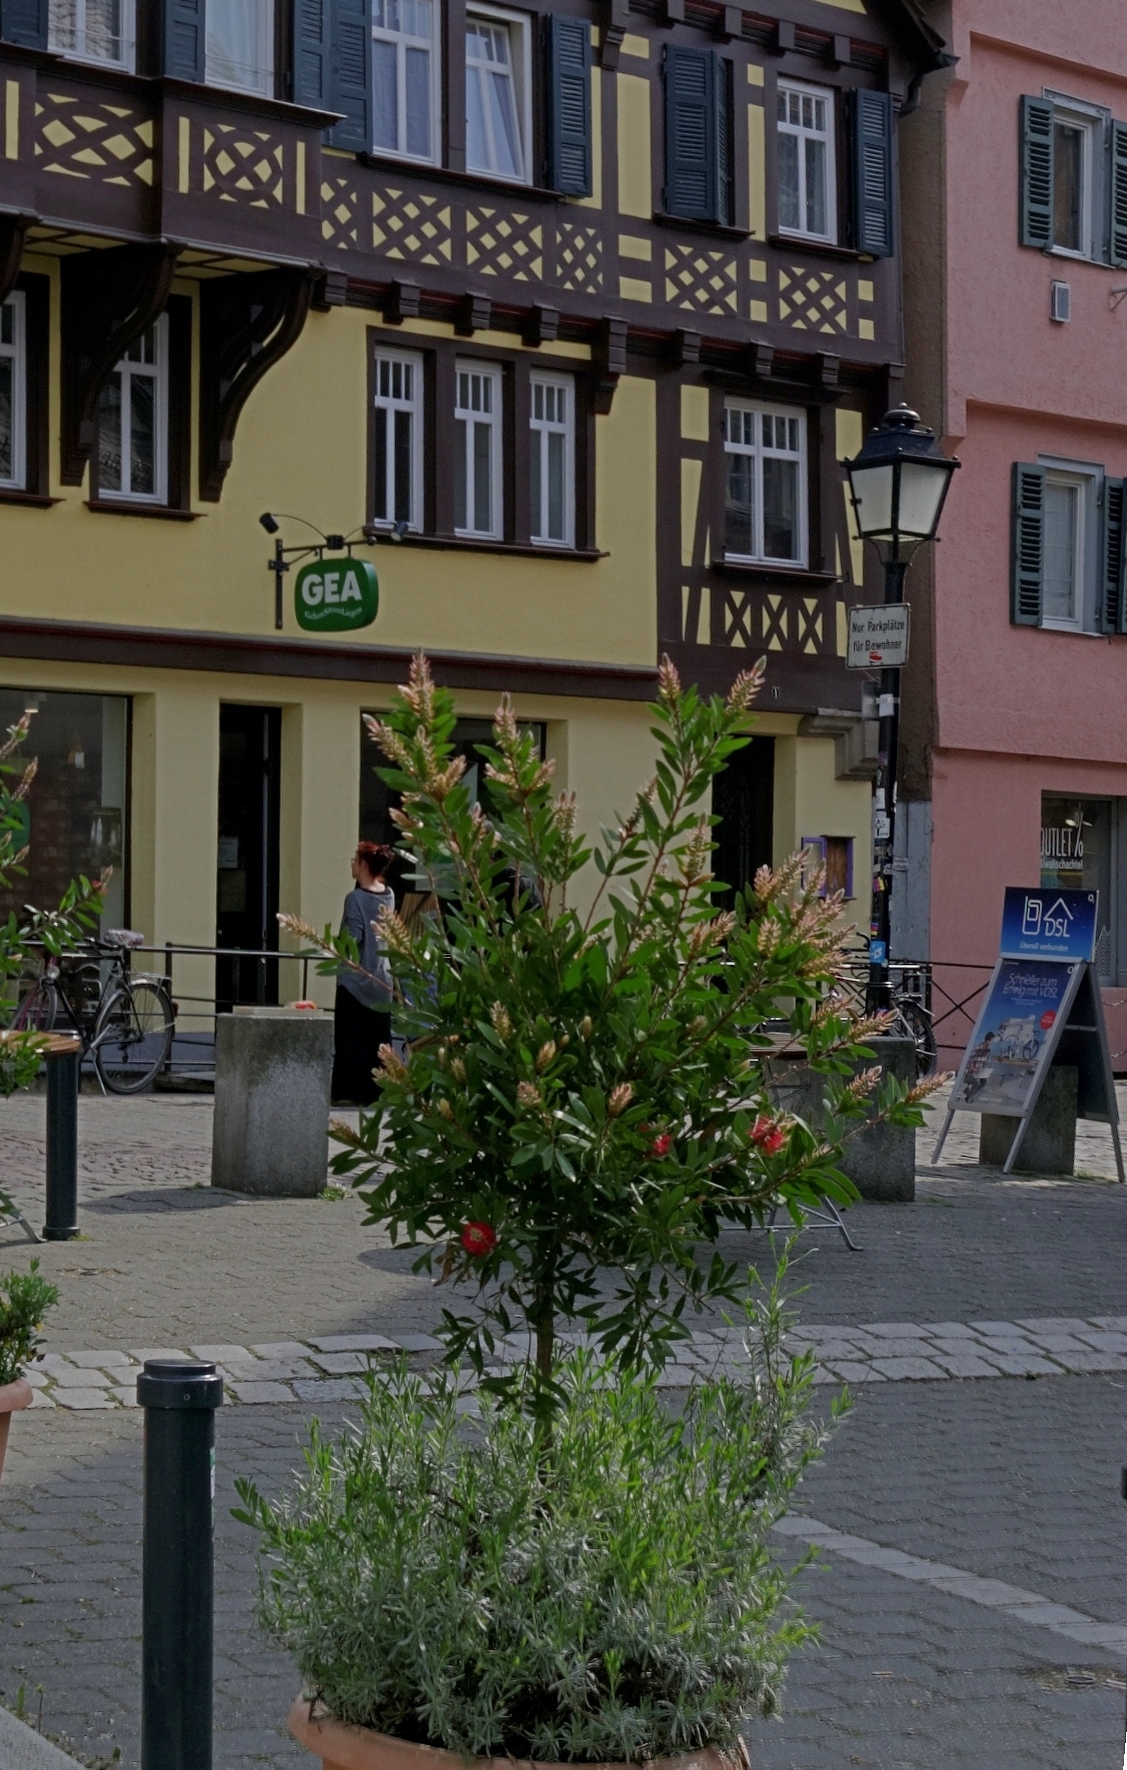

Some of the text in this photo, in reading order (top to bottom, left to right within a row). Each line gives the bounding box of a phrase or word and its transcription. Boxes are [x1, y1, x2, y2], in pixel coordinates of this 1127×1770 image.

[302, 571, 362, 606] GEA
[852, 620, 904, 633] Nur Parkplätze
[853, 639, 902, 651] für Bewohner
[1044, 918, 1070, 938] DSL
